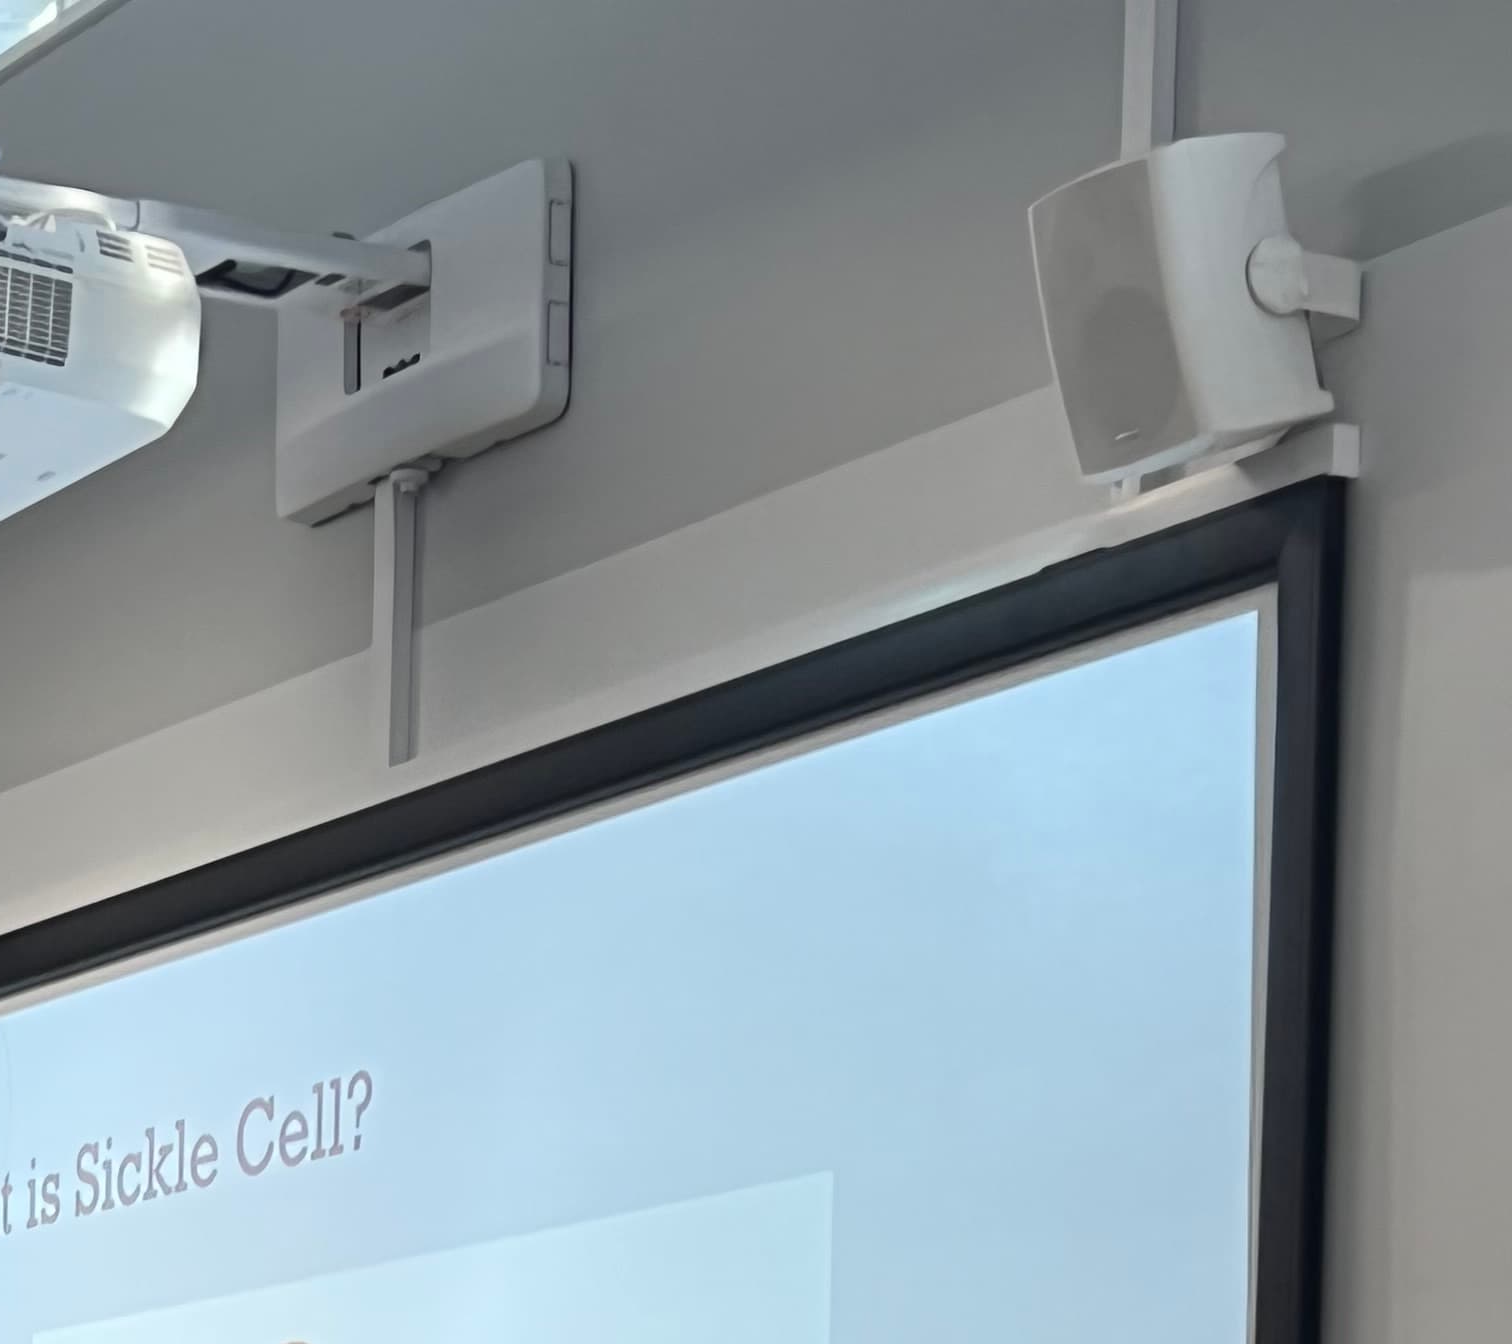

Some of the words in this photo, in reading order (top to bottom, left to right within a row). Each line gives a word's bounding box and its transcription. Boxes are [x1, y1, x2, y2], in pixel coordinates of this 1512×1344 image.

[26, 1158, 60, 1229] is
[74, 1119, 219, 1218] Sickle
[236, 1069, 373, 1176] Cell?
